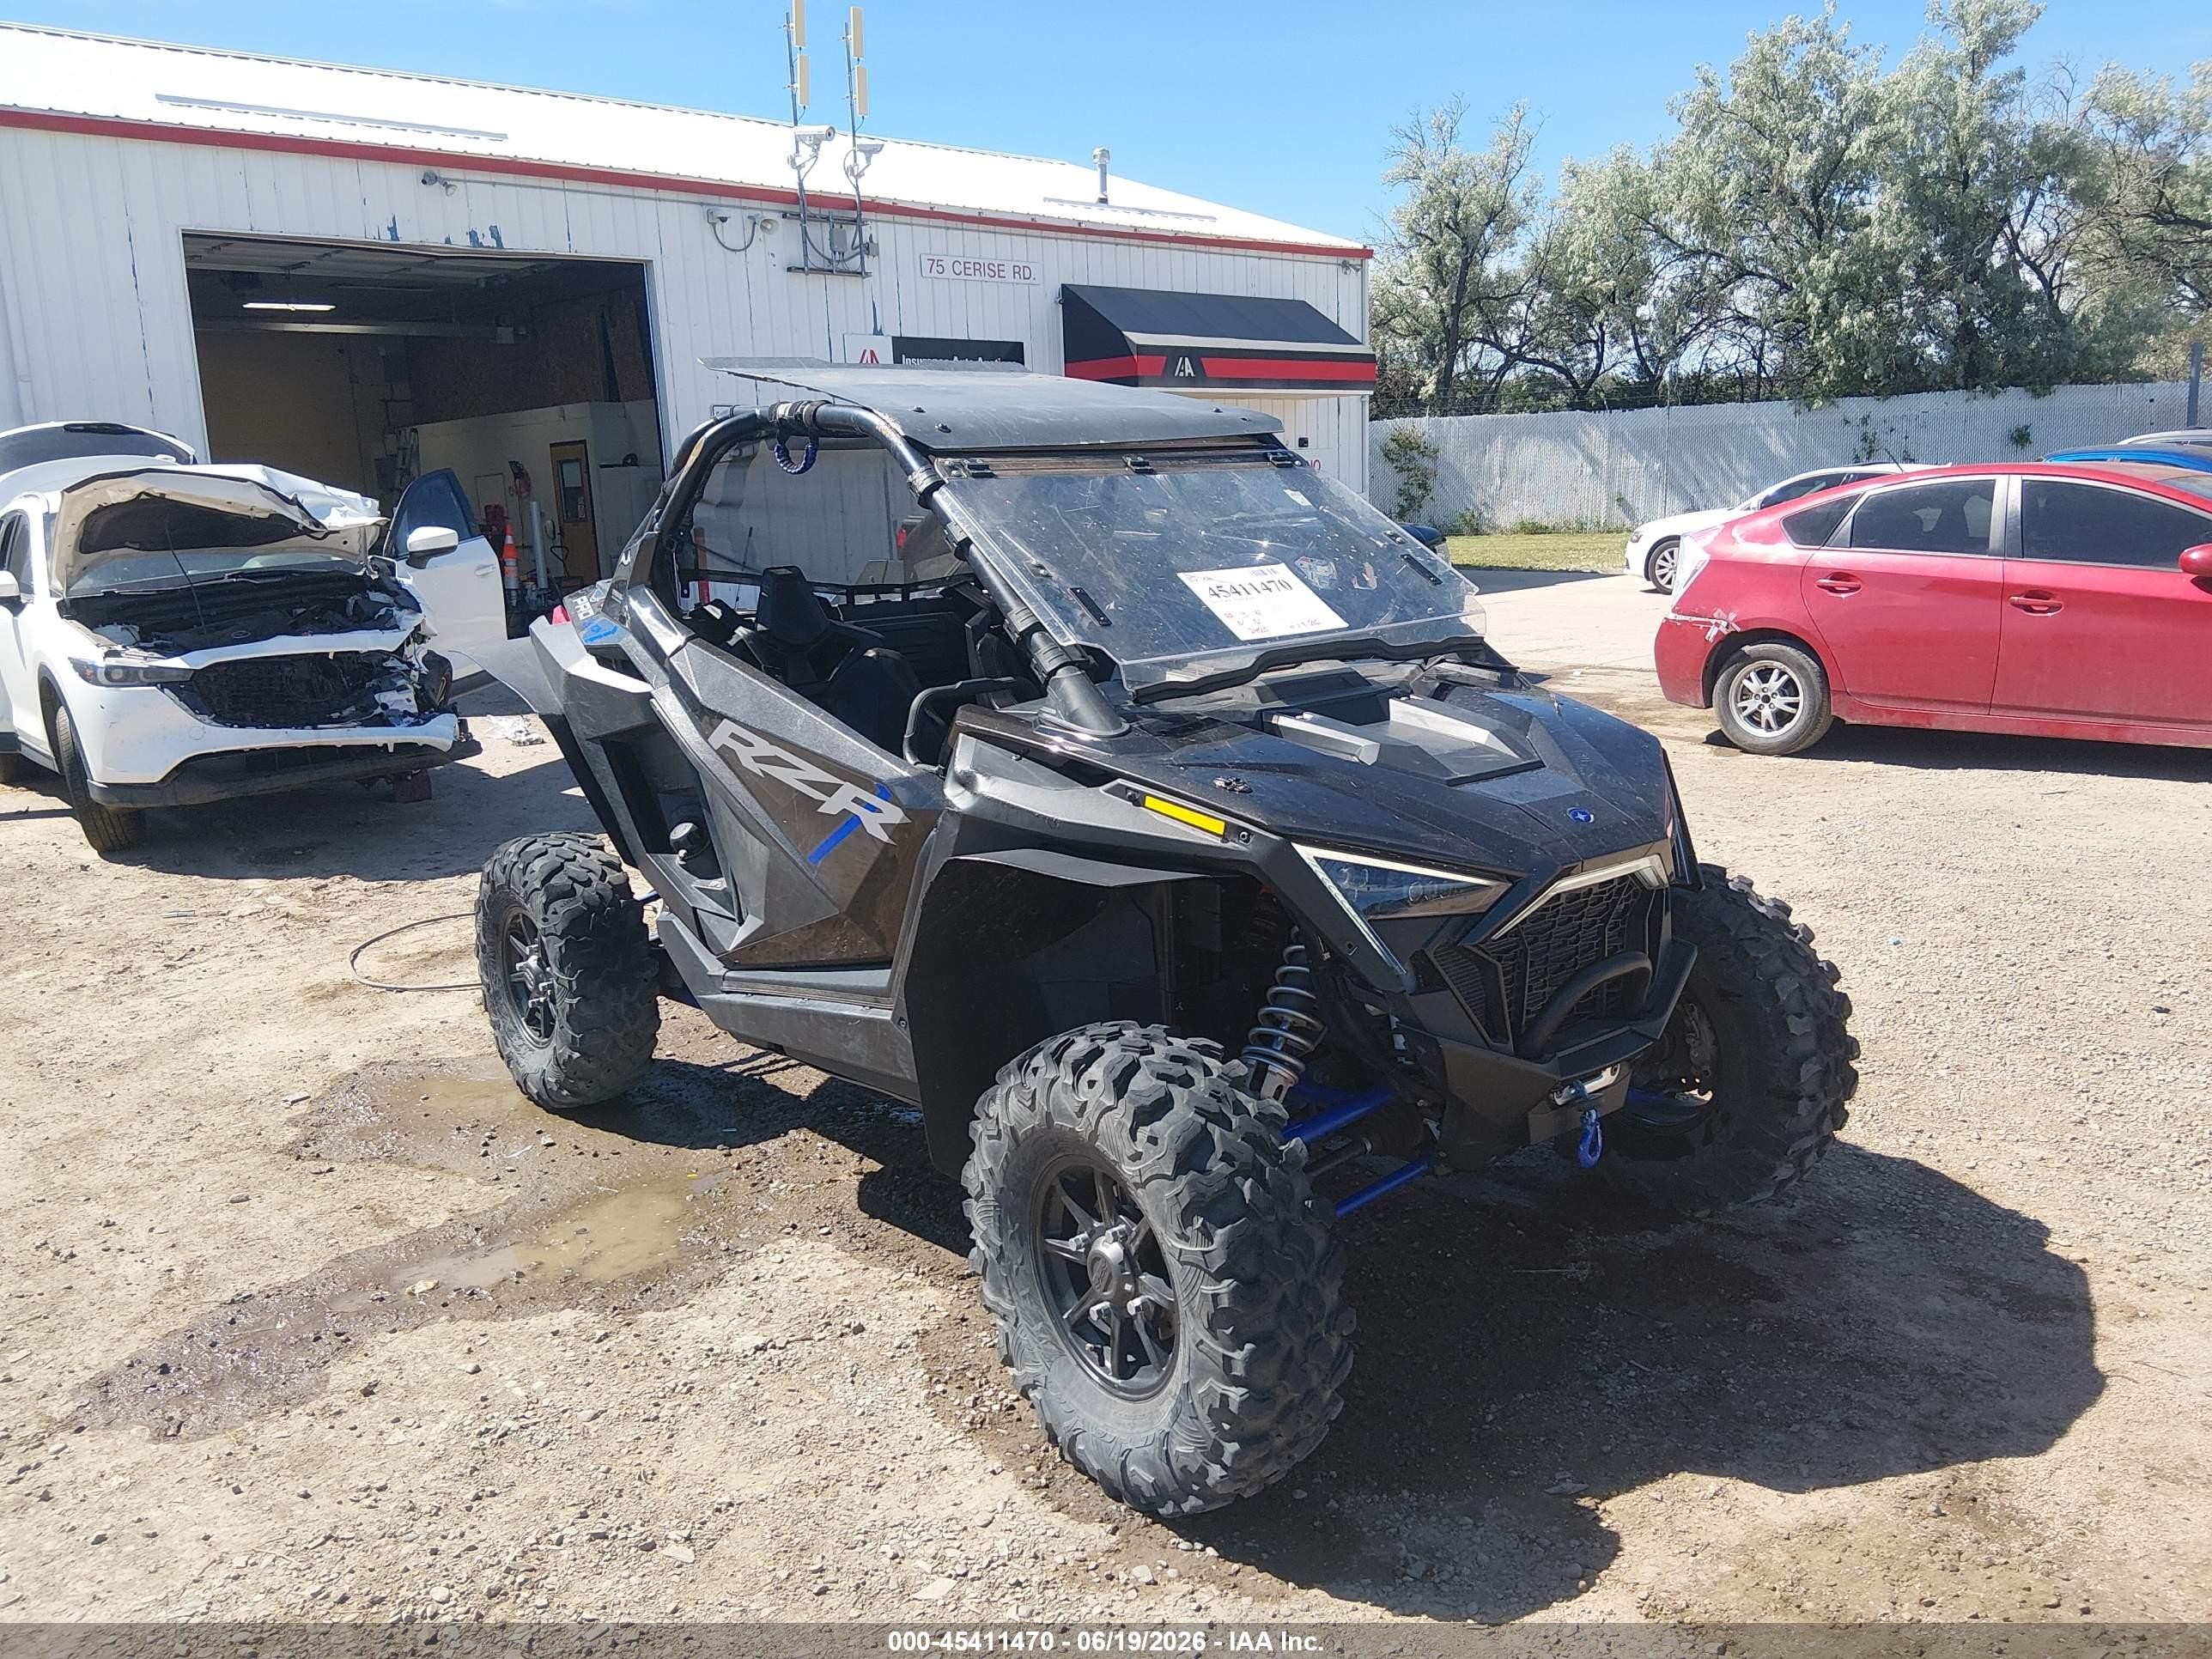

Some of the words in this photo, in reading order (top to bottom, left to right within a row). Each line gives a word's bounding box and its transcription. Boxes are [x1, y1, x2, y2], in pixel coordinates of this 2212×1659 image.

[927, 258, 945, 275] 75
[951, 260, 1006, 279] CERISE
[1012, 264, 1036, 281] RD.
[1208, 579, 1293, 599] 45411470
[708, 718, 912, 846] RZR
